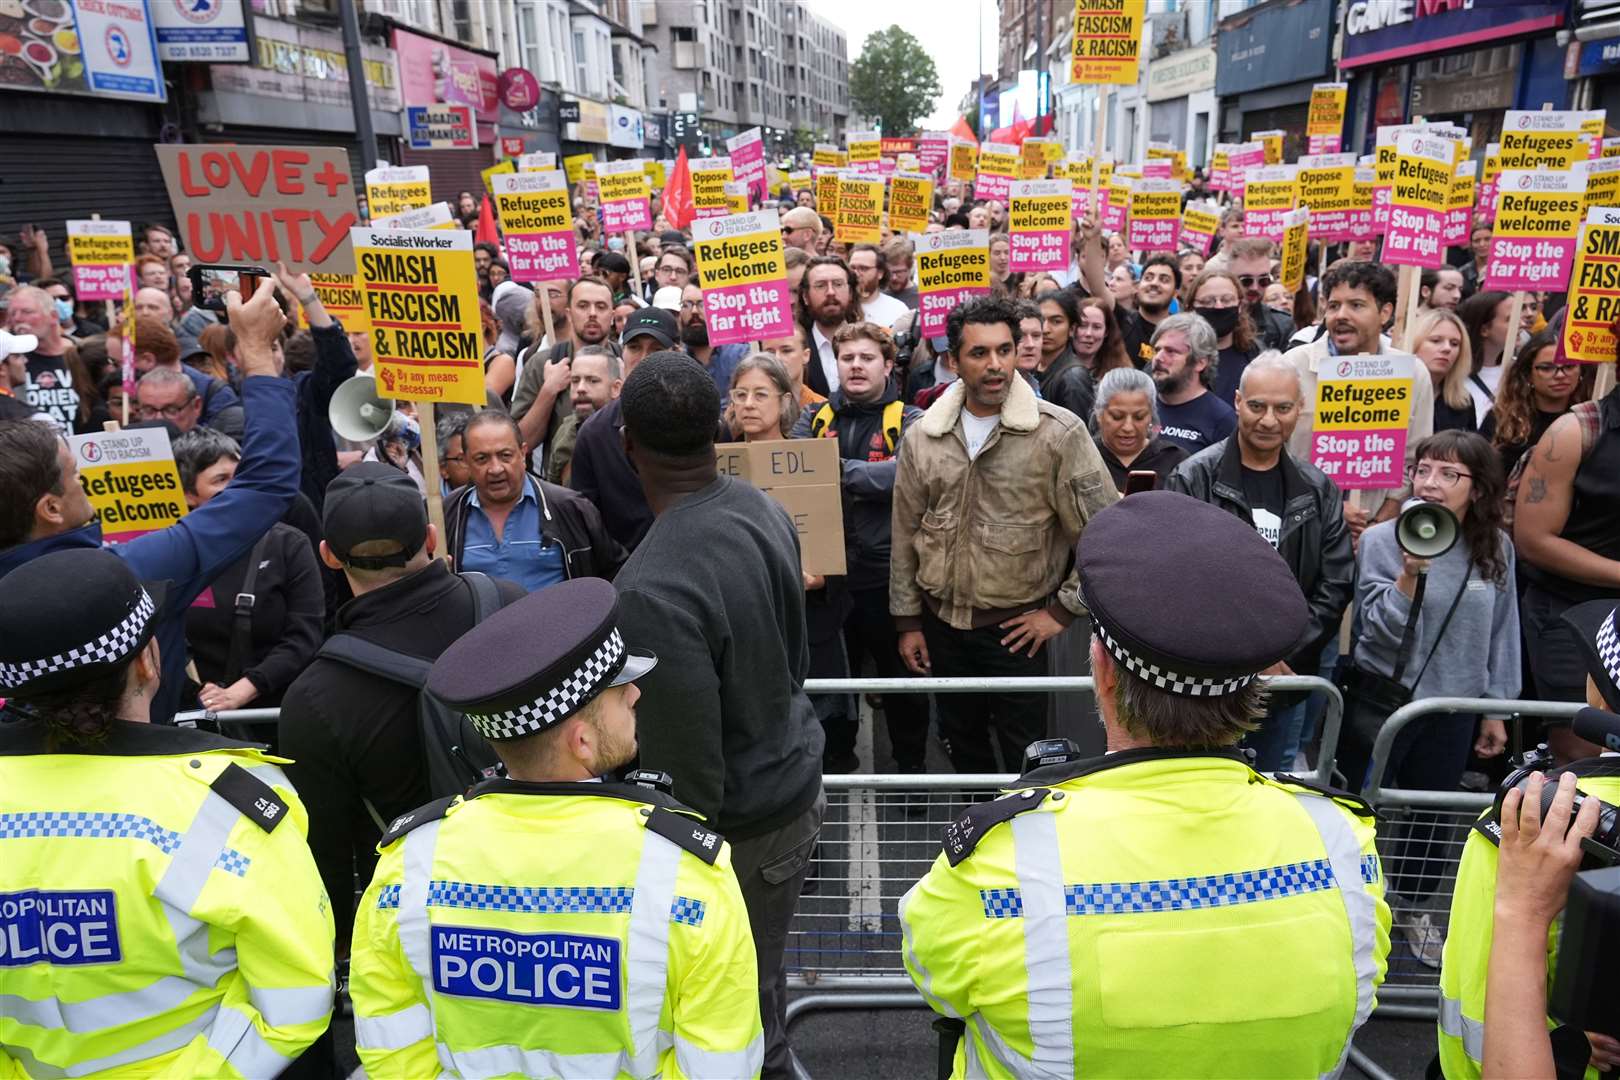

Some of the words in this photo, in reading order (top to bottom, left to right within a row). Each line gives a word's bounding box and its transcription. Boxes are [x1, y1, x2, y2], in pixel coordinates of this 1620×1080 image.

[1077, 16, 1132, 33] FASCISM
[1075, 40, 1085, 56] &
[1089, 40, 1137, 57] RACISM
[1503, 135, 1573, 153] Refugees
[1501, 153, 1566, 168] welcome
[178, 149, 310, 198] LOVE
[314, 161, 349, 197] +
[693, 172, 728, 184] Oppose
[1300, 171, 1343, 184] Oppose
[1399, 160, 1449, 185] Refugees
[600, 174, 643, 187] Refugees
[820, 176, 838, 185] SMAS
[840, 182, 870, 194] SMASH
[893, 179, 919, 191] SMASH
[371, 187, 428, 200] Refugees
[603, 186, 643, 199] welcome
[694, 184, 723, 194] Tomm
[1247, 184, 1293, 196] Refugees
[1300, 185, 1340, 197] Tommy
[1397, 183, 1444, 205] welcome
[501, 196, 566, 213] Refugees
[839, 198, 876, 210] FASCISM
[892, 192, 924, 204] FASCISM
[1133, 193, 1178, 206] Refugees
[1247, 196, 1290, 206] welcome
[1299, 197, 1350, 210] Robinson
[1502, 196, 1579, 215] Refugees
[604, 203, 626, 215] Stop
[627, 201, 644, 211] the
[898, 205, 927, 217] RACISM
[1013, 200, 1068, 215] Refugees
[1133, 204, 1176, 216] welcome
[504, 214, 565, 229] welcome
[606, 214, 620, 225] far
[622, 212, 645, 226] right
[847, 213, 880, 226] RACISM
[1013, 215, 1065, 227] welcome
[1246, 212, 1270, 223] Stop
[1271, 211, 1282, 222] th
[1392, 208, 1424, 233] Stop
[1426, 213, 1440, 233] the
[1500, 215, 1571, 232] welcome
[1132, 221, 1155, 233] Stop
[1156, 220, 1174, 231] the
[1263, 222, 1284, 237] righ
[73, 237, 129, 251] Refugees
[187, 208, 358, 265] UNITY
[1012, 234, 1040, 249] Stop
[1041, 233, 1063, 246] the
[1132, 232, 1146, 243] far
[1148, 231, 1172, 245] right
[1389, 231, 1411, 249] far
[1414, 234, 1438, 255] right
[508, 238, 539, 255] Stop
[542, 235, 567, 251] the
[700, 239, 778, 262] Refugees
[1495, 240, 1533, 259] Stop
[1536, 240, 1565, 258] the
[76, 250, 129, 262] welcome
[511, 256, 531, 271] far
[534, 253, 570, 271] right
[920, 253, 986, 271] Refugees
[1012, 249, 1029, 262] far
[1031, 249, 1062, 265] right
[77, 267, 107, 281] Stop
[361, 252, 438, 284] SMASH
[704, 260, 777, 282] welcome
[1491, 261, 1516, 278] far
[1518, 261, 1559, 282] right
[79, 280, 97, 291] far
[922, 271, 983, 287] welcome
[707, 292, 746, 311] Stop
[749, 286, 779, 305] the
[922, 294, 956, 311] Stop
[367, 291, 461, 323] FASCISM
[1573, 295, 1589, 320] &
[710, 313, 736, 332] far
[740, 307, 781, 330] right
[923, 312, 945, 327] far
[375, 328, 391, 356] &
[395, 329, 479, 360] RACISM
[1586, 331, 1598, 344] By
[1354, 361, 1378, 370] STAND
[1379, 360, 1391, 369] UP
[1354, 368, 1366, 377] TO
[1366, 367, 1394, 377] RACISM
[397, 369, 408, 383] By
[410, 371, 425, 384] any
[428, 373, 459, 383] means
[399, 384, 444, 397] necessary
[1321, 384, 1407, 405] Refugees
[1319, 406, 1400, 424] welcome
[101, 438, 130, 450] STAND
[130, 436, 143, 448] UP
[1315, 435, 1360, 457] Stop
[1364, 433, 1395, 452] the
[104, 450, 118, 461] TO
[119, 447, 151, 460] RACISM
[771, 451, 815, 474] EDL
[1314, 456, 1342, 475] far
[1346, 455, 1392, 478] right
[79, 470, 177, 498] Refugees
[254, 797, 270, 811] EA
[960, 815, 974, 839] EA
[0, 898, 107, 917] OPOLITAN
[438, 932, 612, 963] METROPOLITAN
[438, 955, 612, 1003] POLICE
